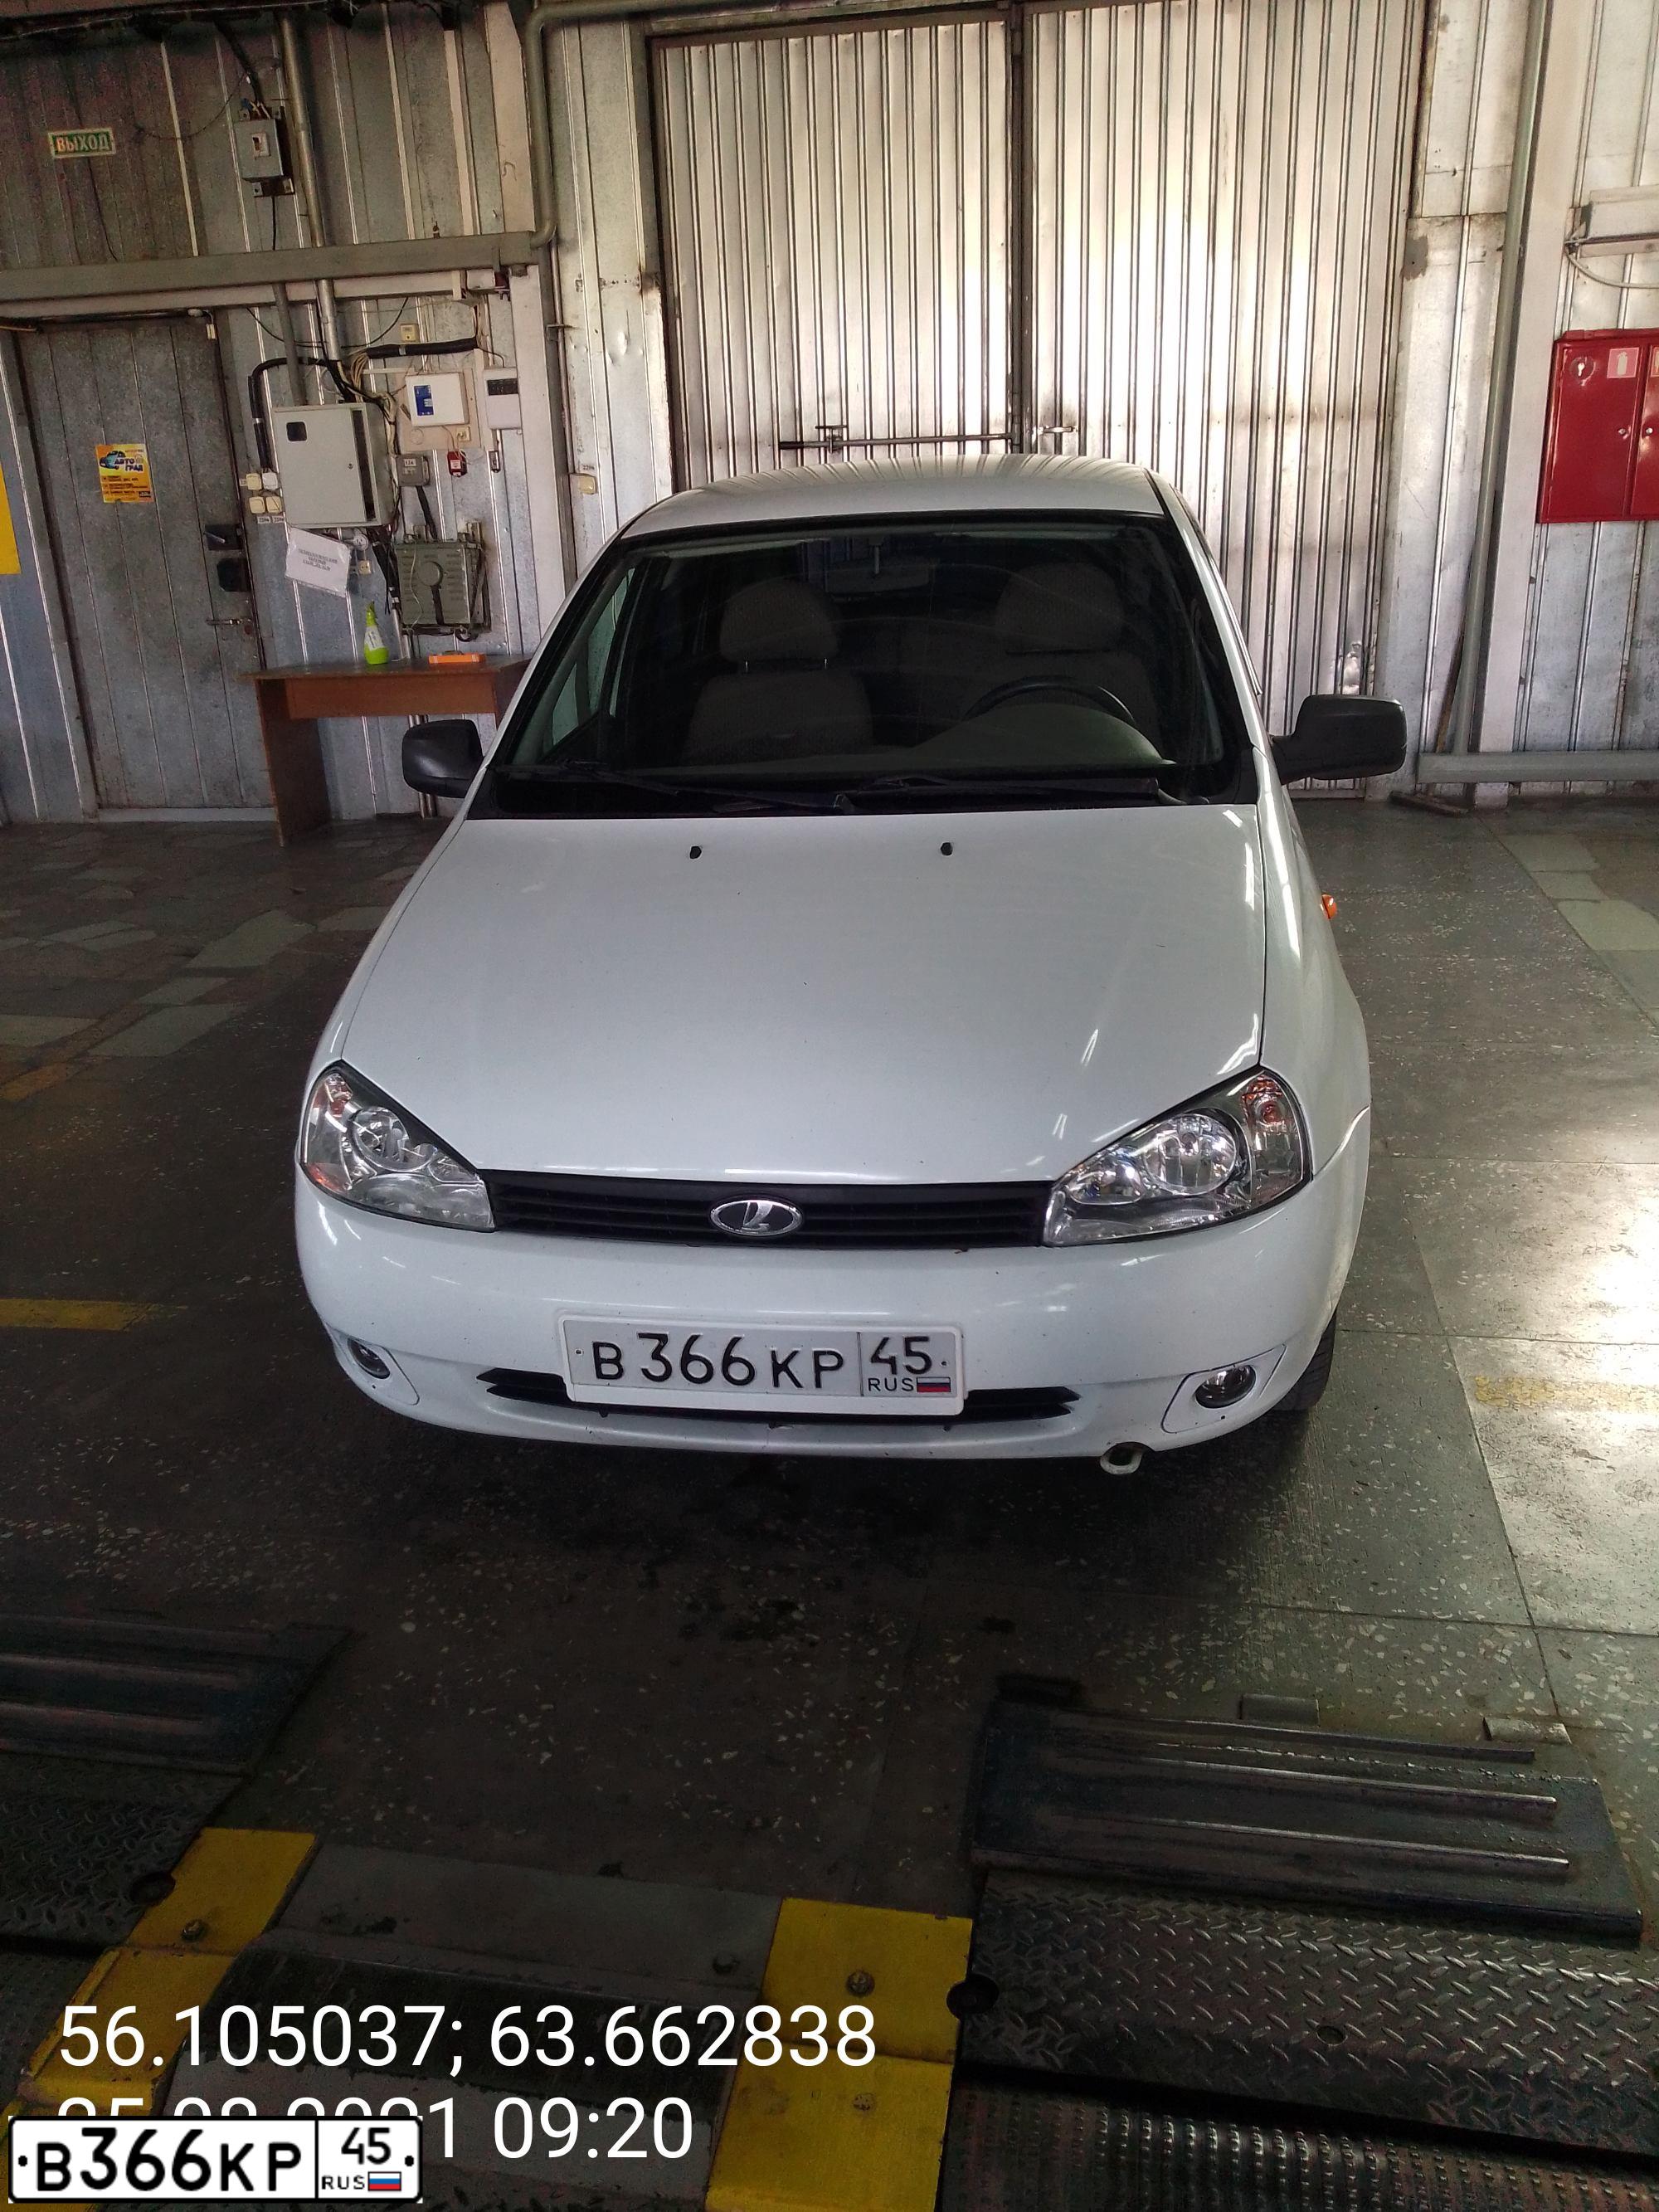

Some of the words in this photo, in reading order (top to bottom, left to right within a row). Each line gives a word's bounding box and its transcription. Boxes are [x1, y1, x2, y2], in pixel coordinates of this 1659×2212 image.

[56, 134, 110, 153] ВЫХОД
[870, 1337, 932, 1376] 45
[868, 1377, 914, 1393] RUS
